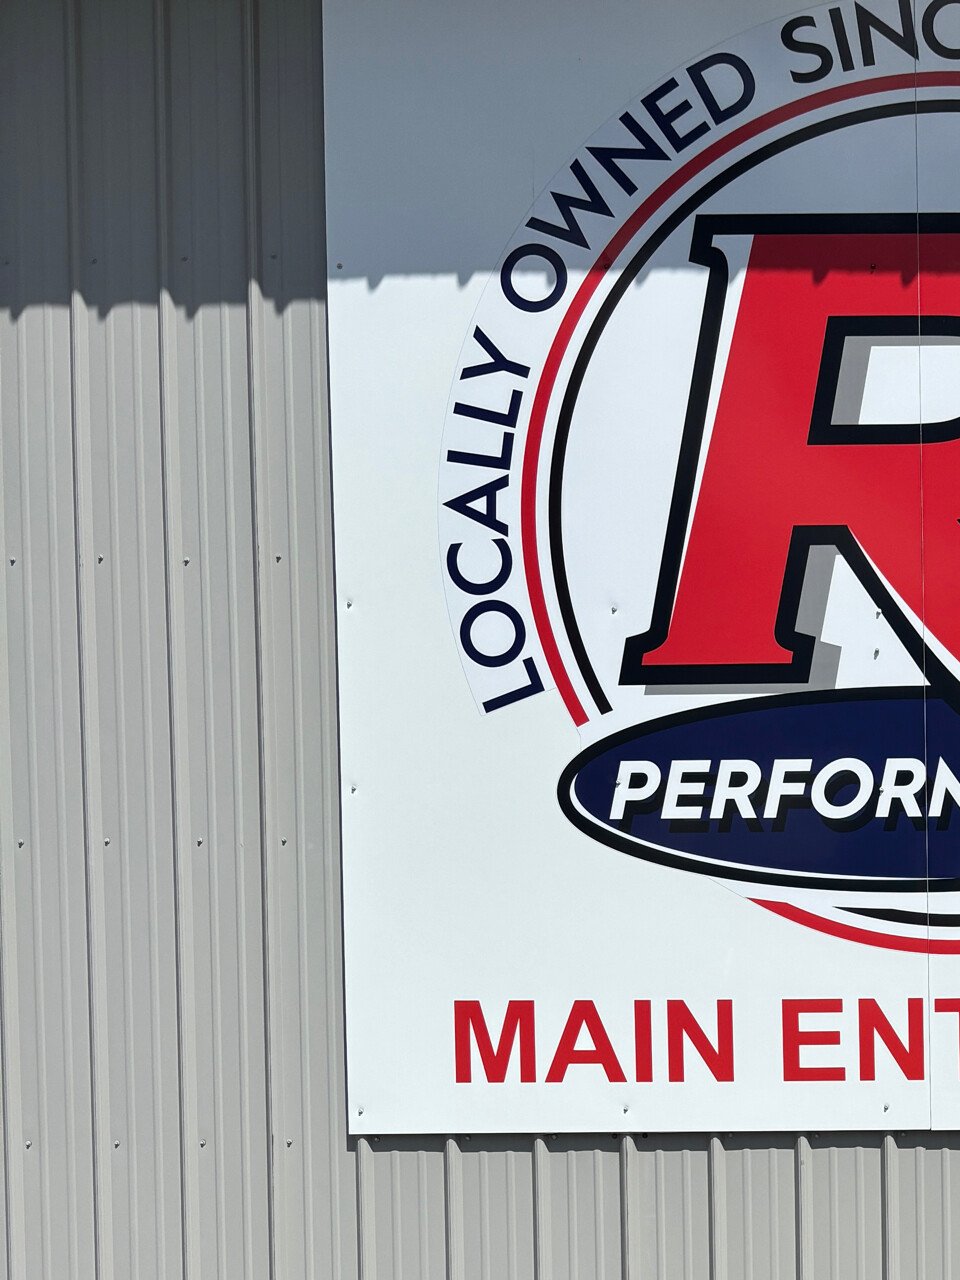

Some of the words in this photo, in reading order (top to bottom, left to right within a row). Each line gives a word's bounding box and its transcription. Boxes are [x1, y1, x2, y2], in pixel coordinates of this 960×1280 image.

[442, 325, 545, 713] LOCALLY
[501, 52, 756, 313] OWNED
[455, 1001, 734, 1083] MAIN
